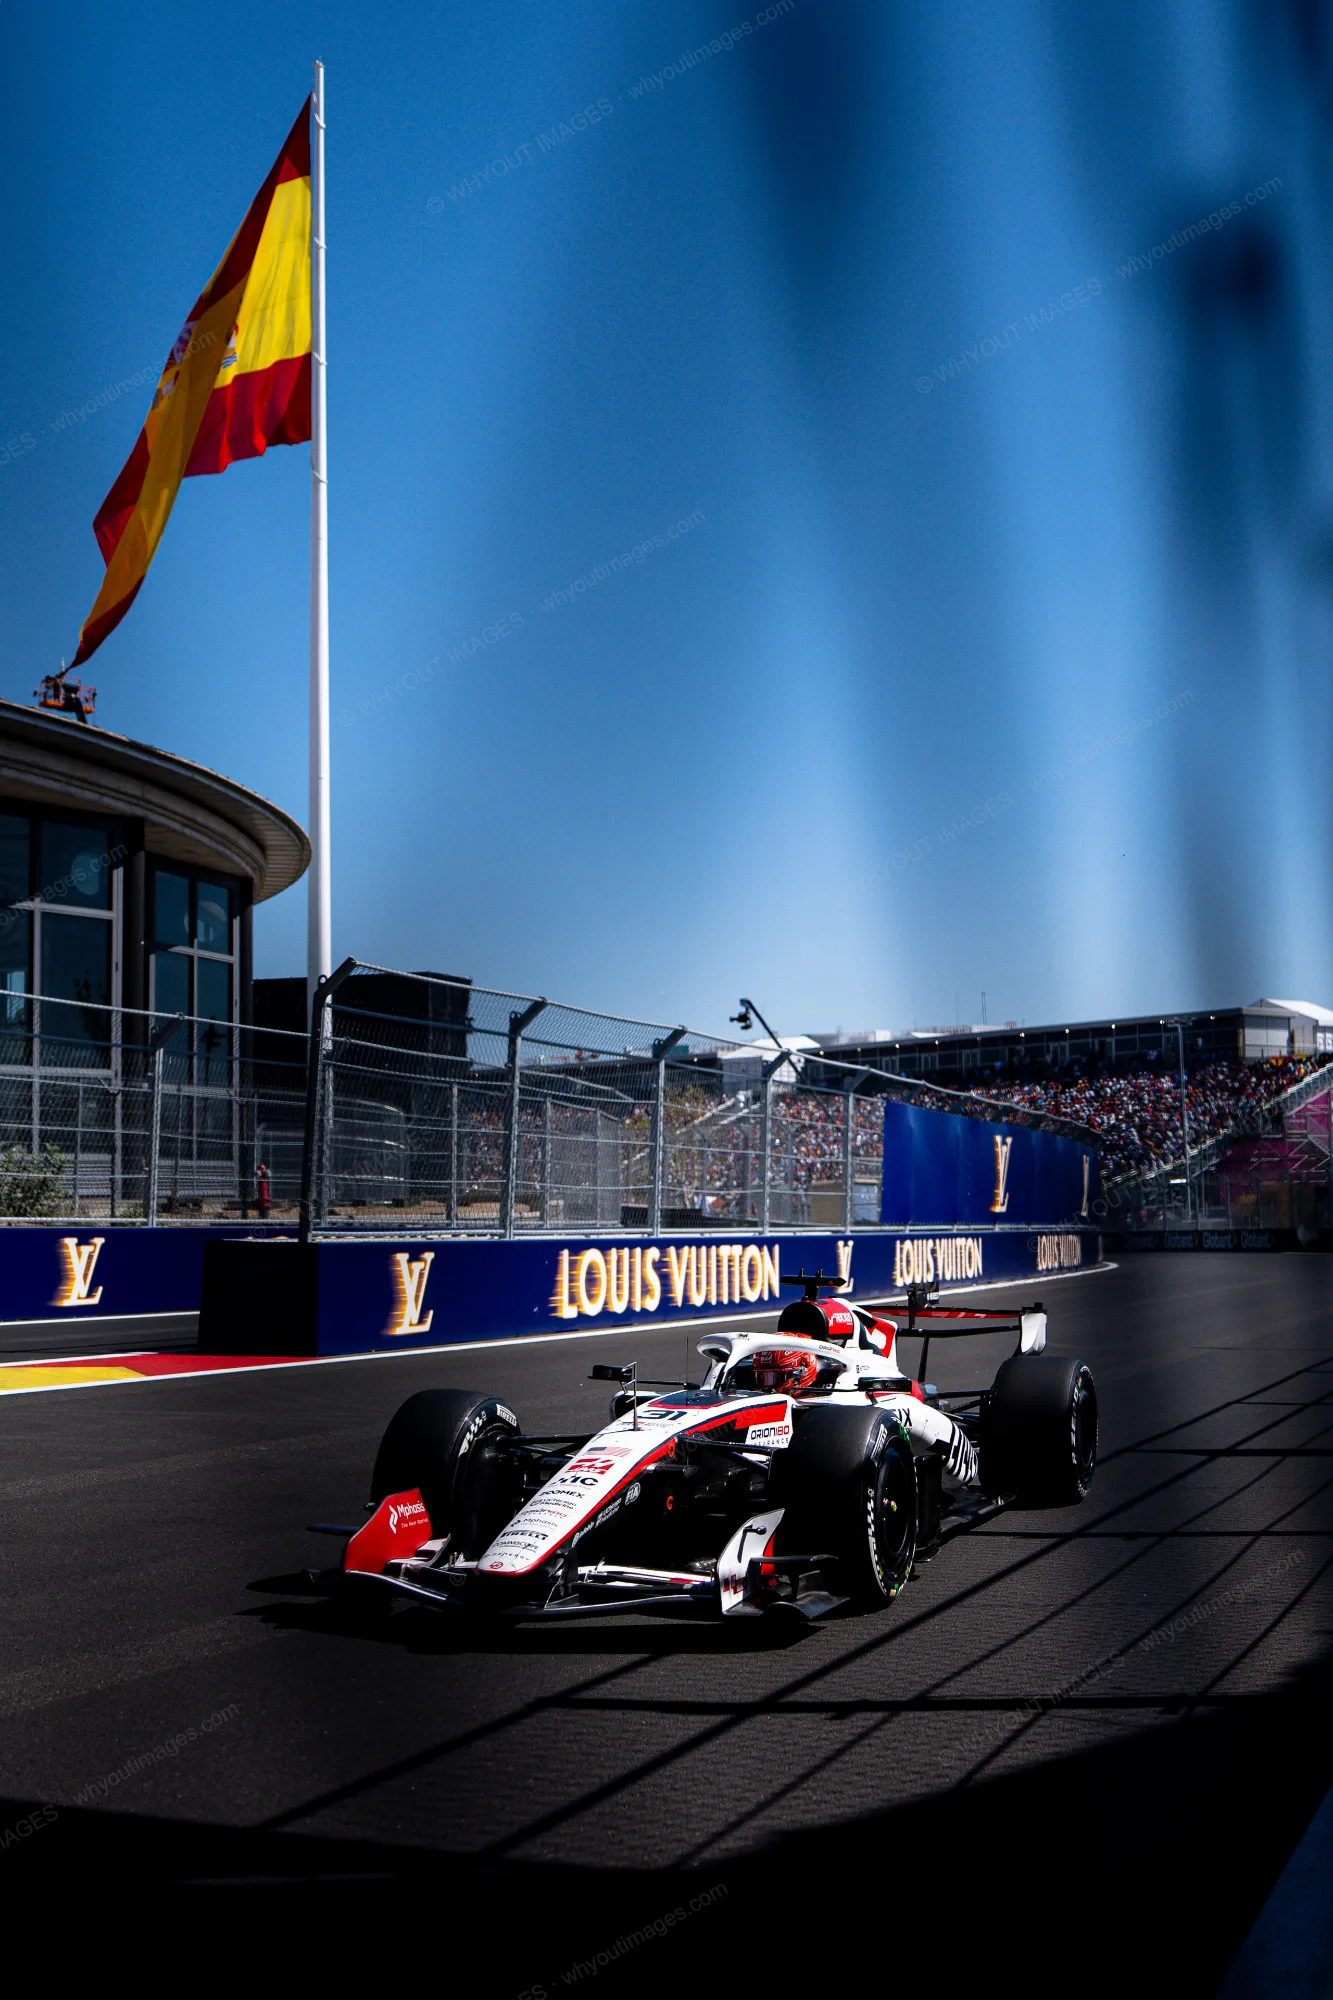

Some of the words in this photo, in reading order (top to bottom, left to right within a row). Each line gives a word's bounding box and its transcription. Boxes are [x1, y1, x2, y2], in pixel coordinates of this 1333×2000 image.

[893, 1239, 934, 1287] LOUIS
[936, 1237, 983, 1280] VUITTON
[1036, 1235, 1058, 1270] LOUIS
[1059, 1235, 1082, 1267] VUITTON
[556, 1246, 661, 1319] LOUIS
[667, 1244, 780, 1307] VUITTON
[637, 1409, 688, 1421] 31
[397, 1501, 426, 1519] Mphasis
